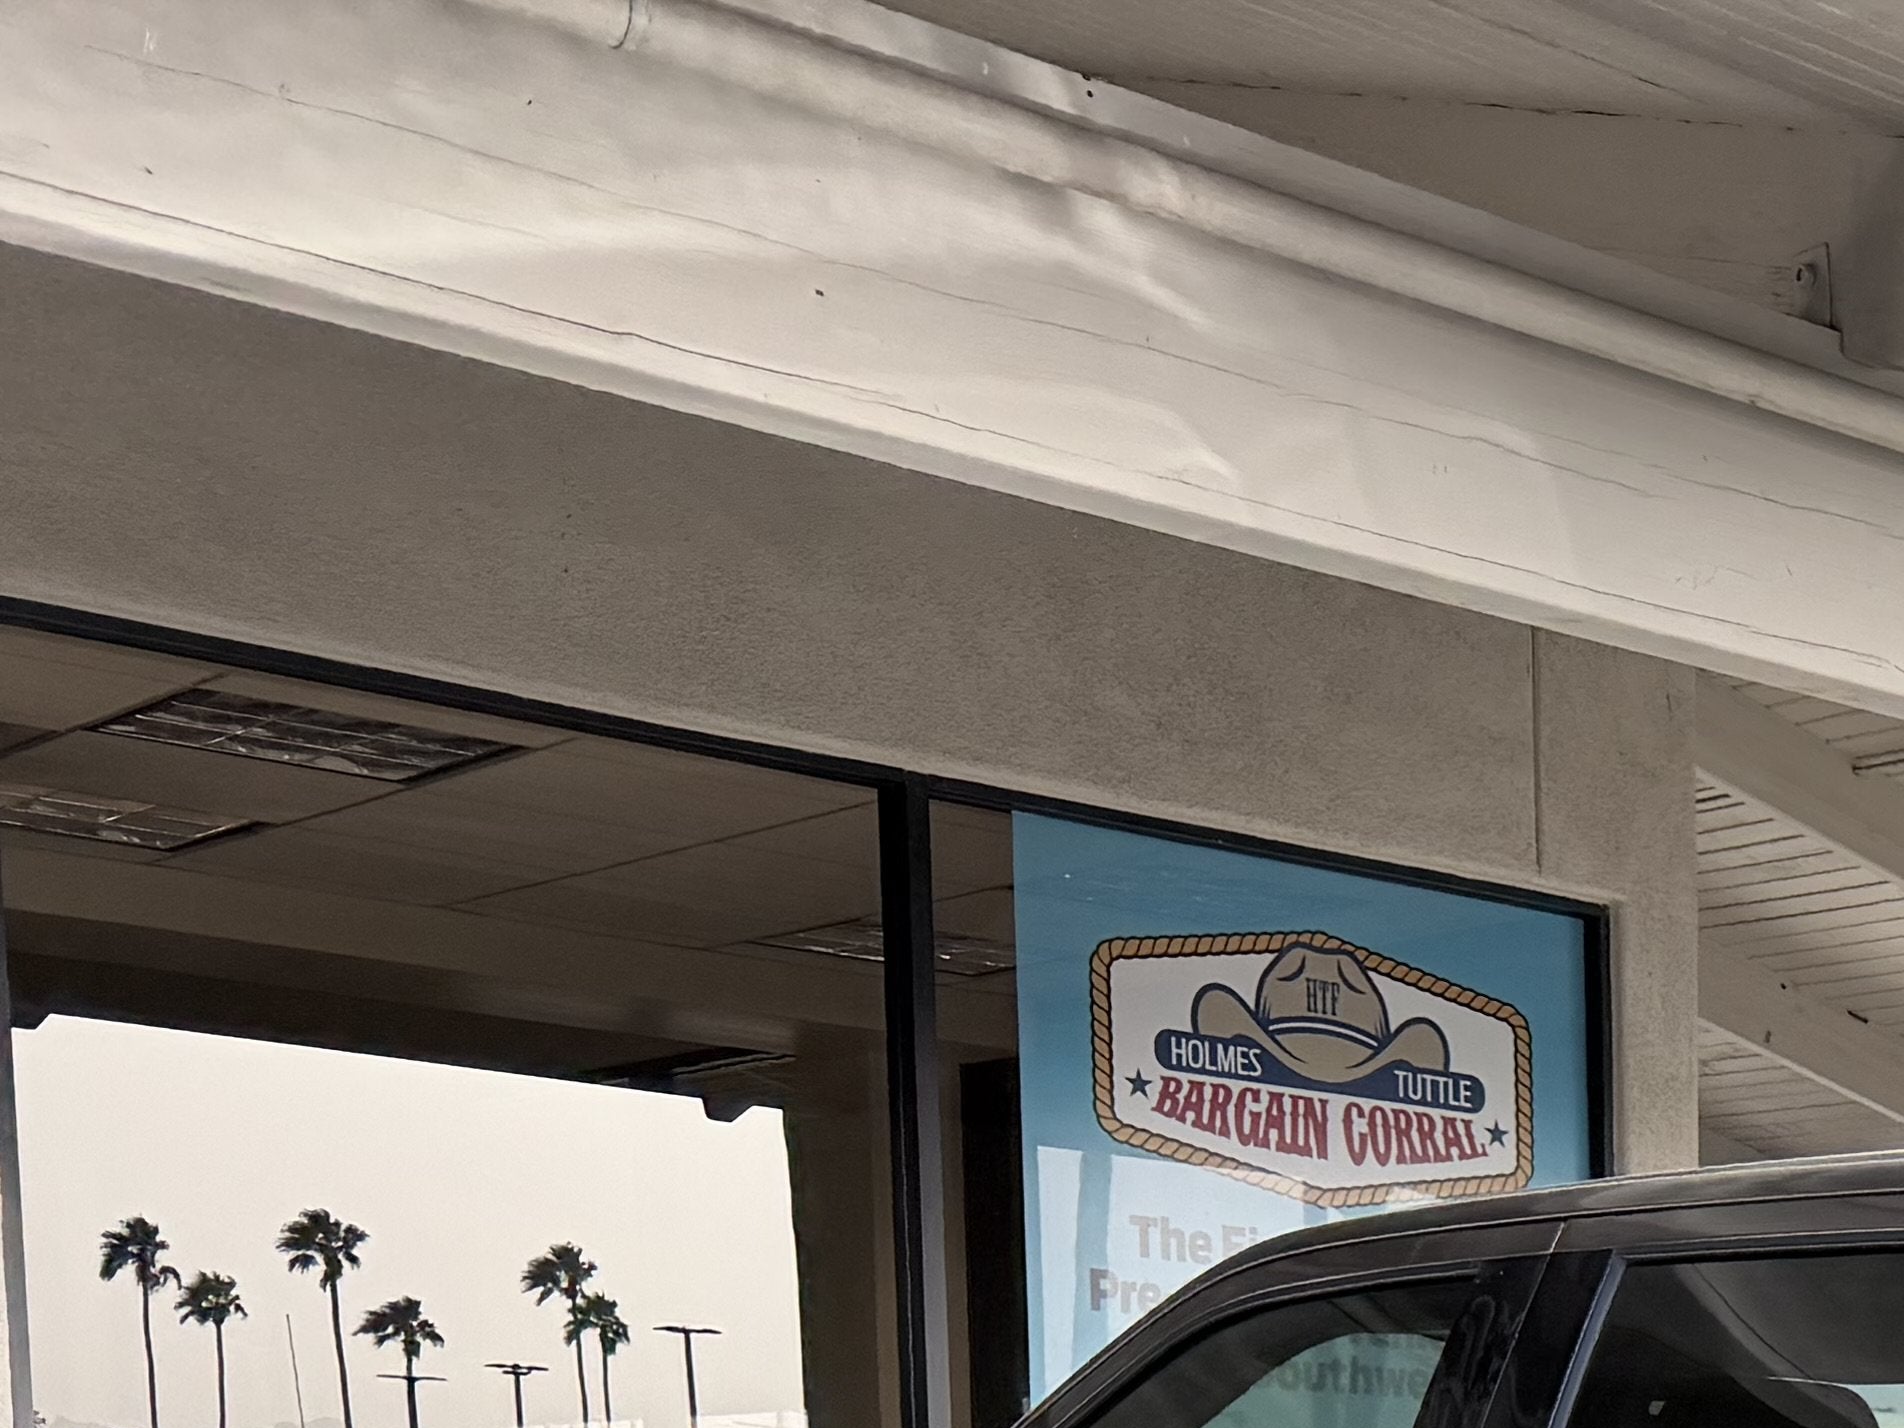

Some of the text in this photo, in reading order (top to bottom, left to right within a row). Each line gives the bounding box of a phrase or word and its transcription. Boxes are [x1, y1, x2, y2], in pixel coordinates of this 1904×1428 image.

[1170, 1036, 1473, 1108] HOLMES TUTTLE
[1151, 1075, 1488, 1167] BARGAIN CORRAL
[1128, 1214, 1213, 1265] The
